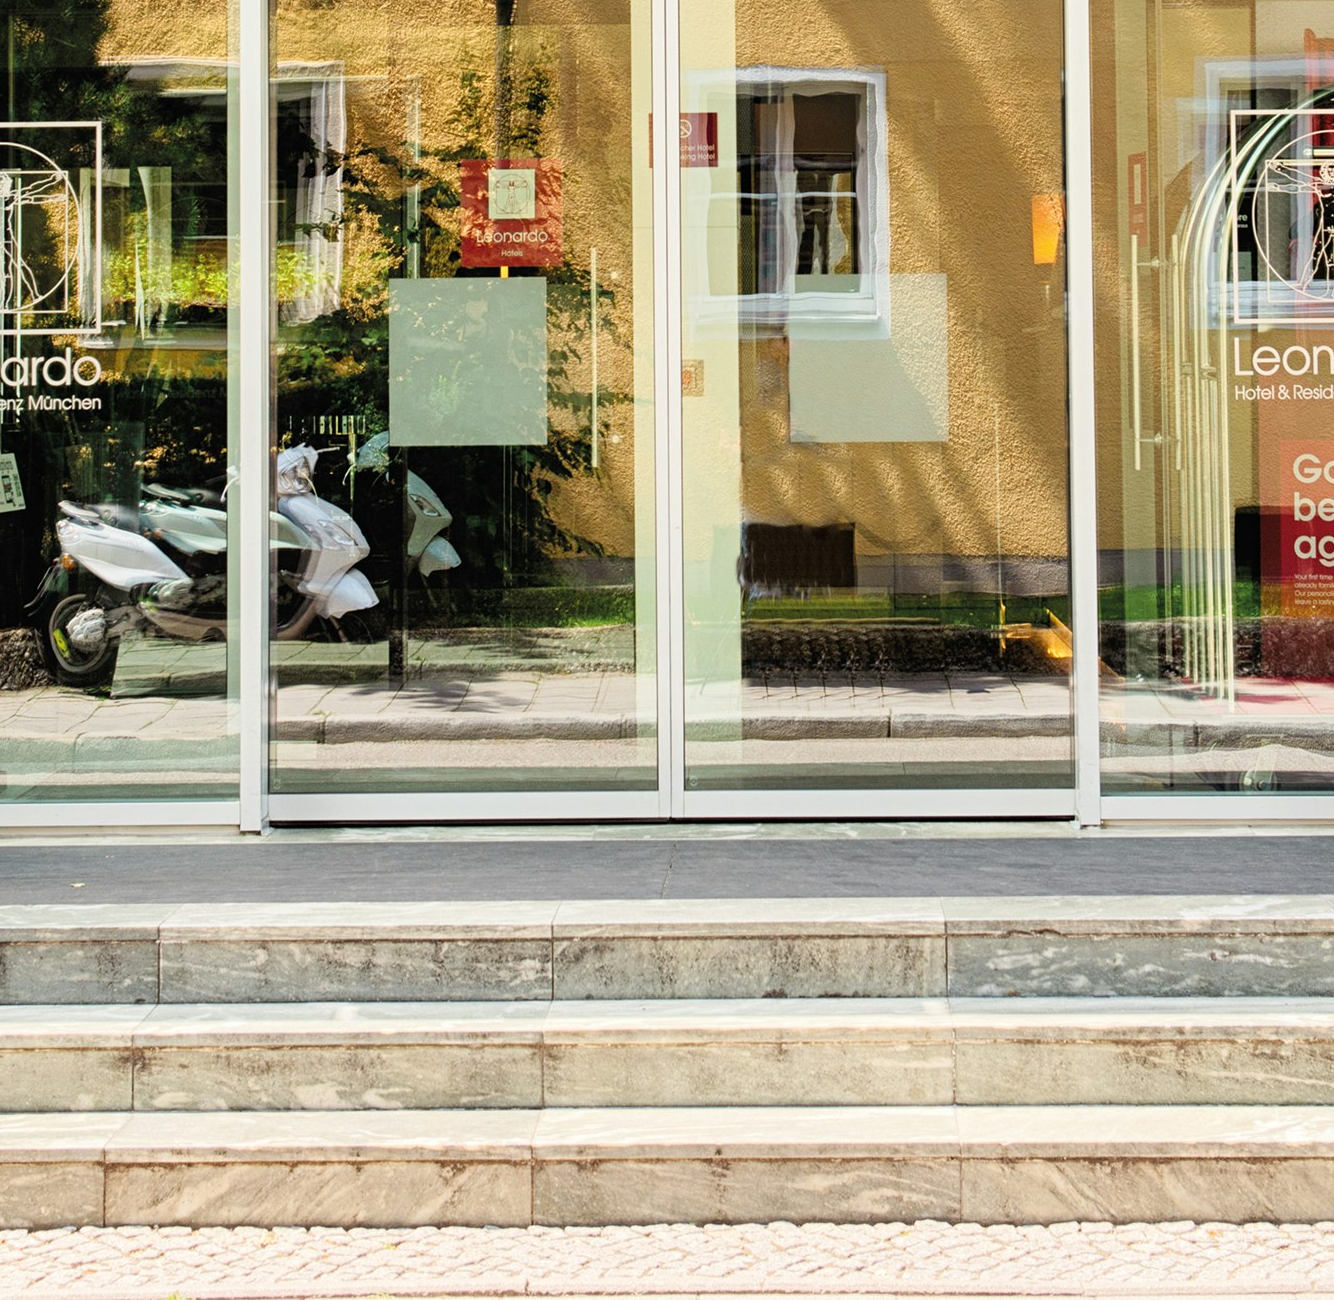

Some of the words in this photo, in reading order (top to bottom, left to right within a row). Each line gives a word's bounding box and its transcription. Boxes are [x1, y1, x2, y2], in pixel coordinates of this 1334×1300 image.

[476, 230, 549, 243] Leonardo
[501, 249, 524, 257] Hotels
[1235, 384, 1275, 400] Hotel
[1278, 385, 1291, 399] &
[28, 394, 102, 410] München
[1294, 589, 1306, 597] Our
